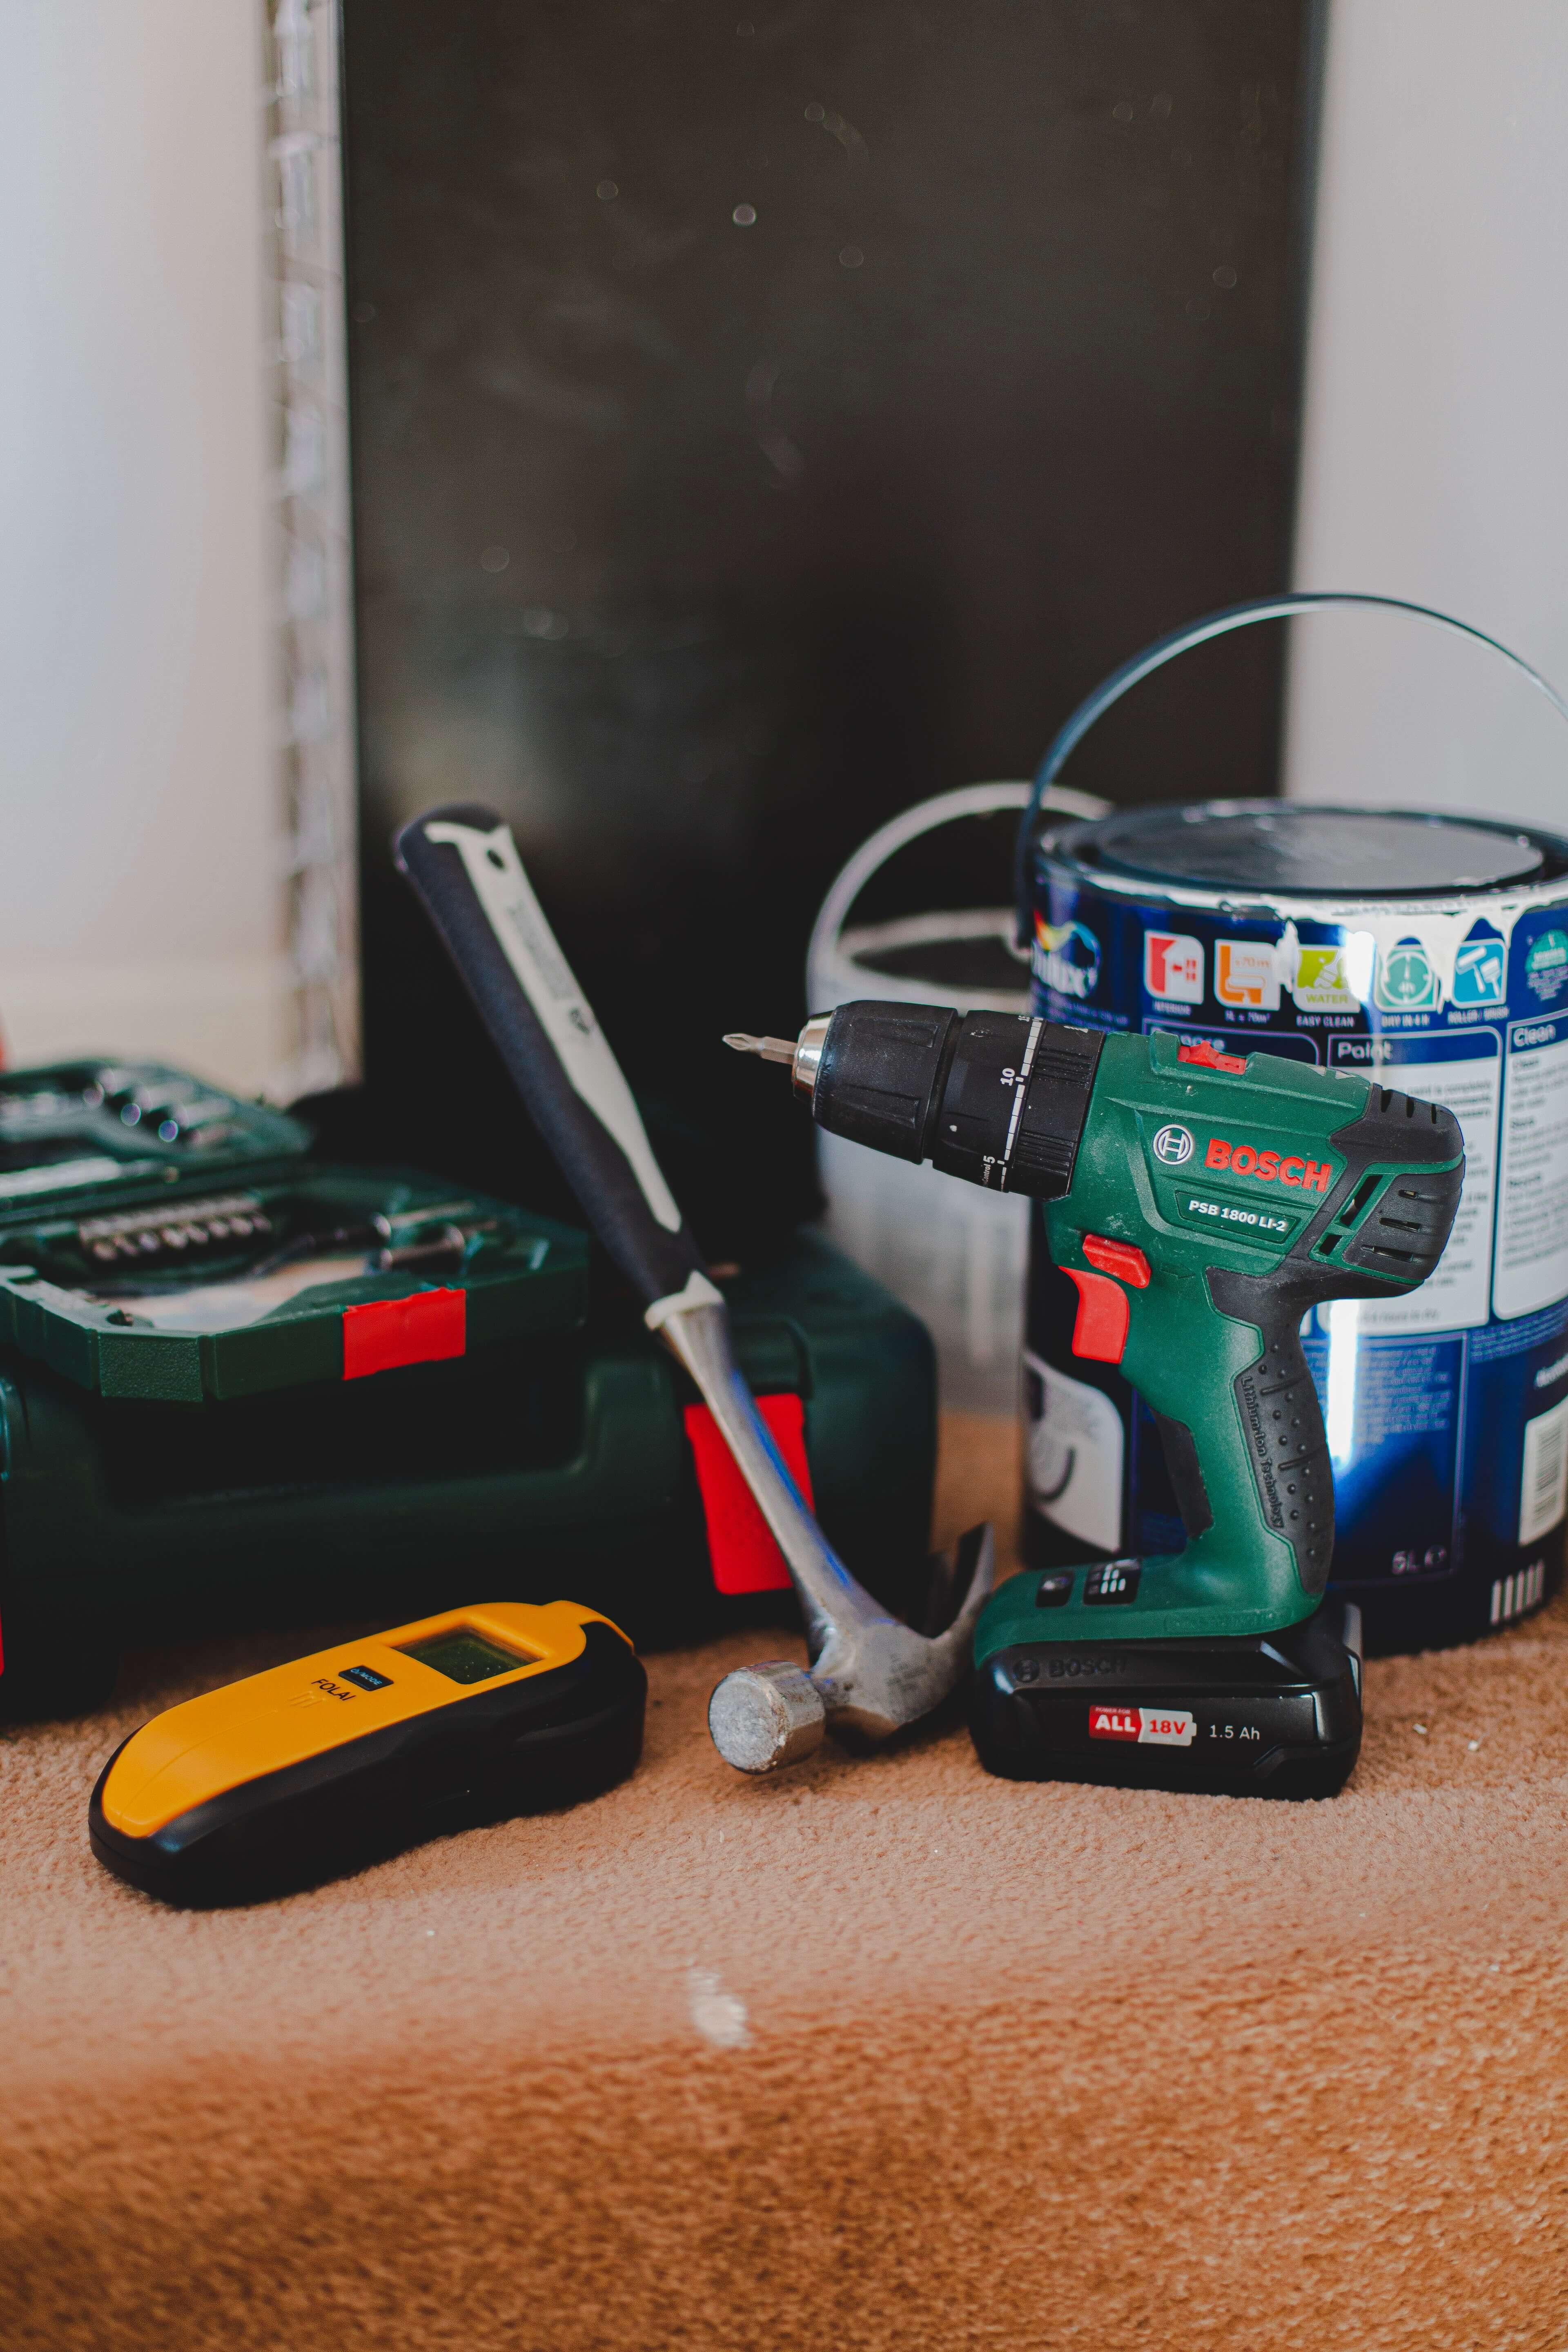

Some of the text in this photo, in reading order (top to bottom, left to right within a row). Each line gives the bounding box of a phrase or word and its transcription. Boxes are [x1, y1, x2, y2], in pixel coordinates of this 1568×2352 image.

[1306, 993, 1347, 1004] WATER
[1296, 1015, 1354, 1027] EASY CLEAN
[1513, 1025, 1556, 1047] Clean
[1338, 1041, 1392, 1059] Paint
[1000, 1067, 1016, 1086] 10
[983, 1155, 996, 1164] 5
[1204, 1138, 1332, 1192] BOSCH
[1189, 1200, 1287, 1232] PSB 1800 LI-2
[1241, 1376, 1285, 1528] Lithium-Ion Technology
[1049, 1658, 1127, 1677] BOSCH
[311, 1679, 356, 1701] FOLAI
[1095, 1715, 1186, 1735] ALL 18V
[1209, 1725, 1260, 1740] 1.5 Ah
